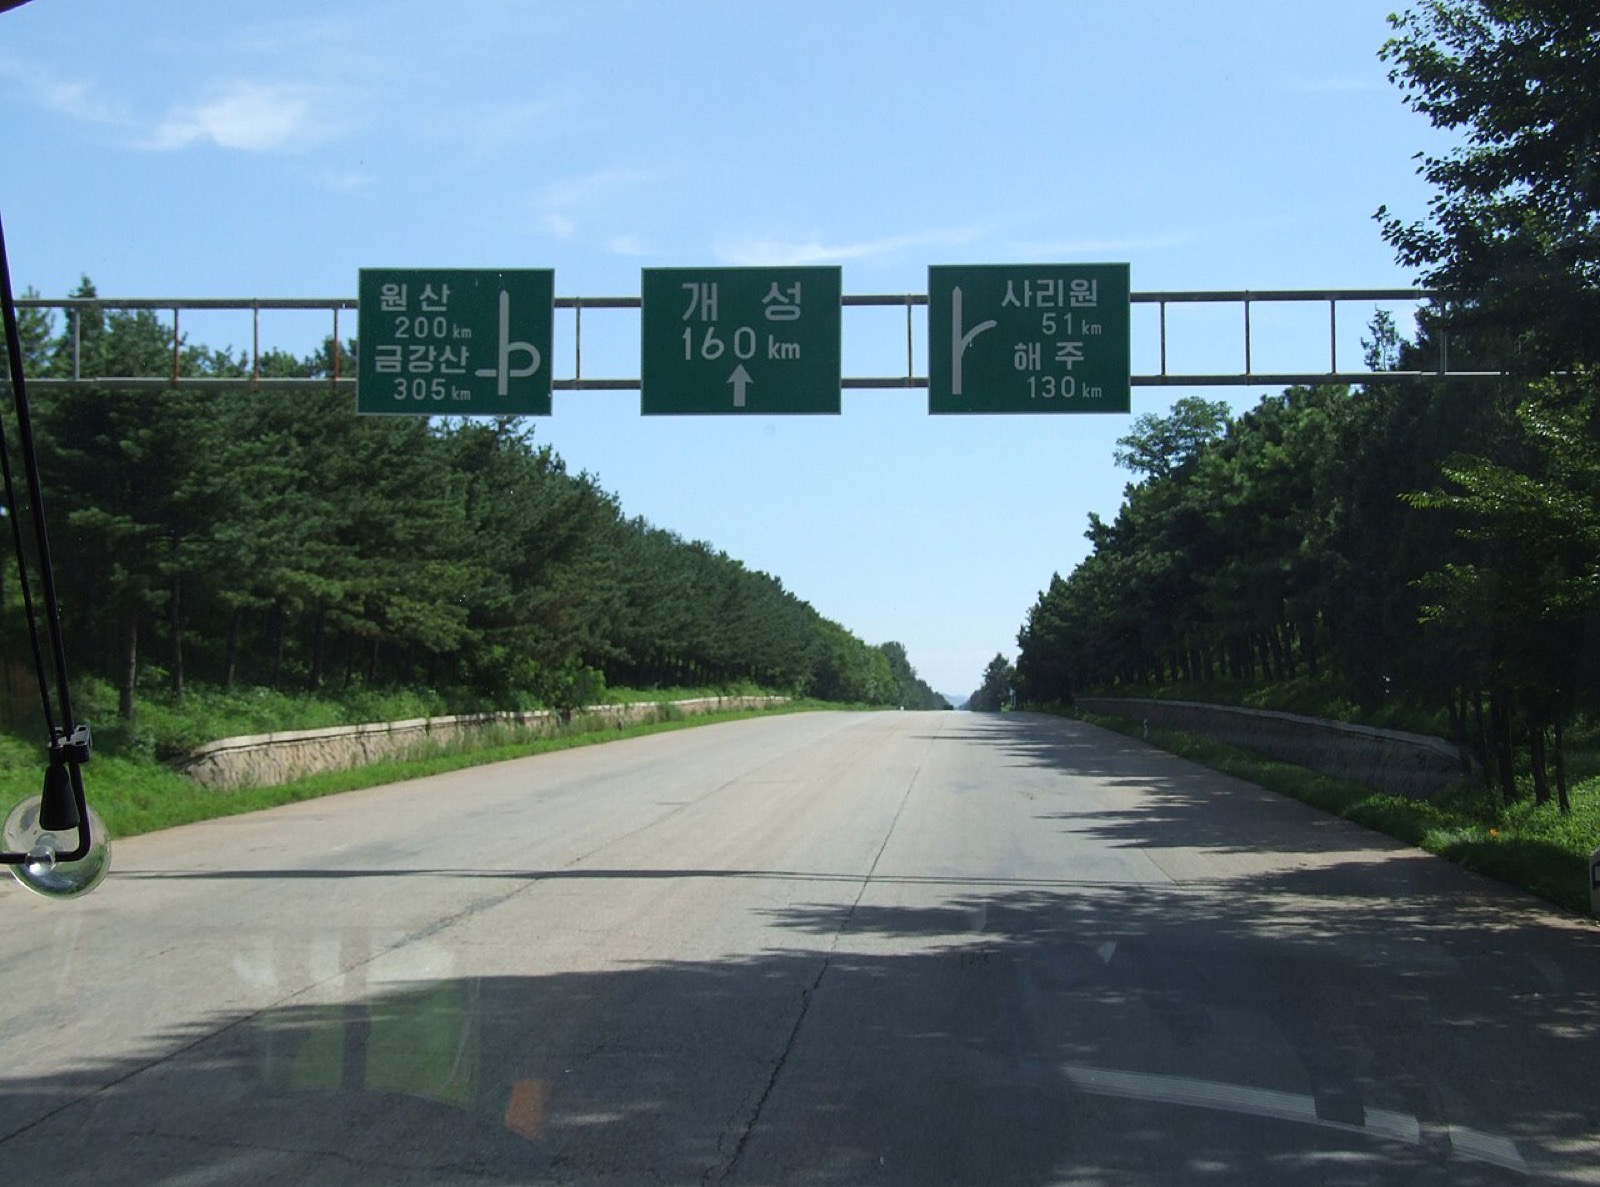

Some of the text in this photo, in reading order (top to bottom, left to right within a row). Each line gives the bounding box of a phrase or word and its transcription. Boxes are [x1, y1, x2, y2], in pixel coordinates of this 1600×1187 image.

[1001, 279, 1097, 308] 사리원
[394, 316, 472, 338] 200 km
[1041, 312, 1102, 335] 51 km
[682, 326, 801, 360] 160 km
[375, 345, 470, 374] 금강산
[393, 378, 471, 400] 305 km
[1026, 375, 1102, 398] 130 km
